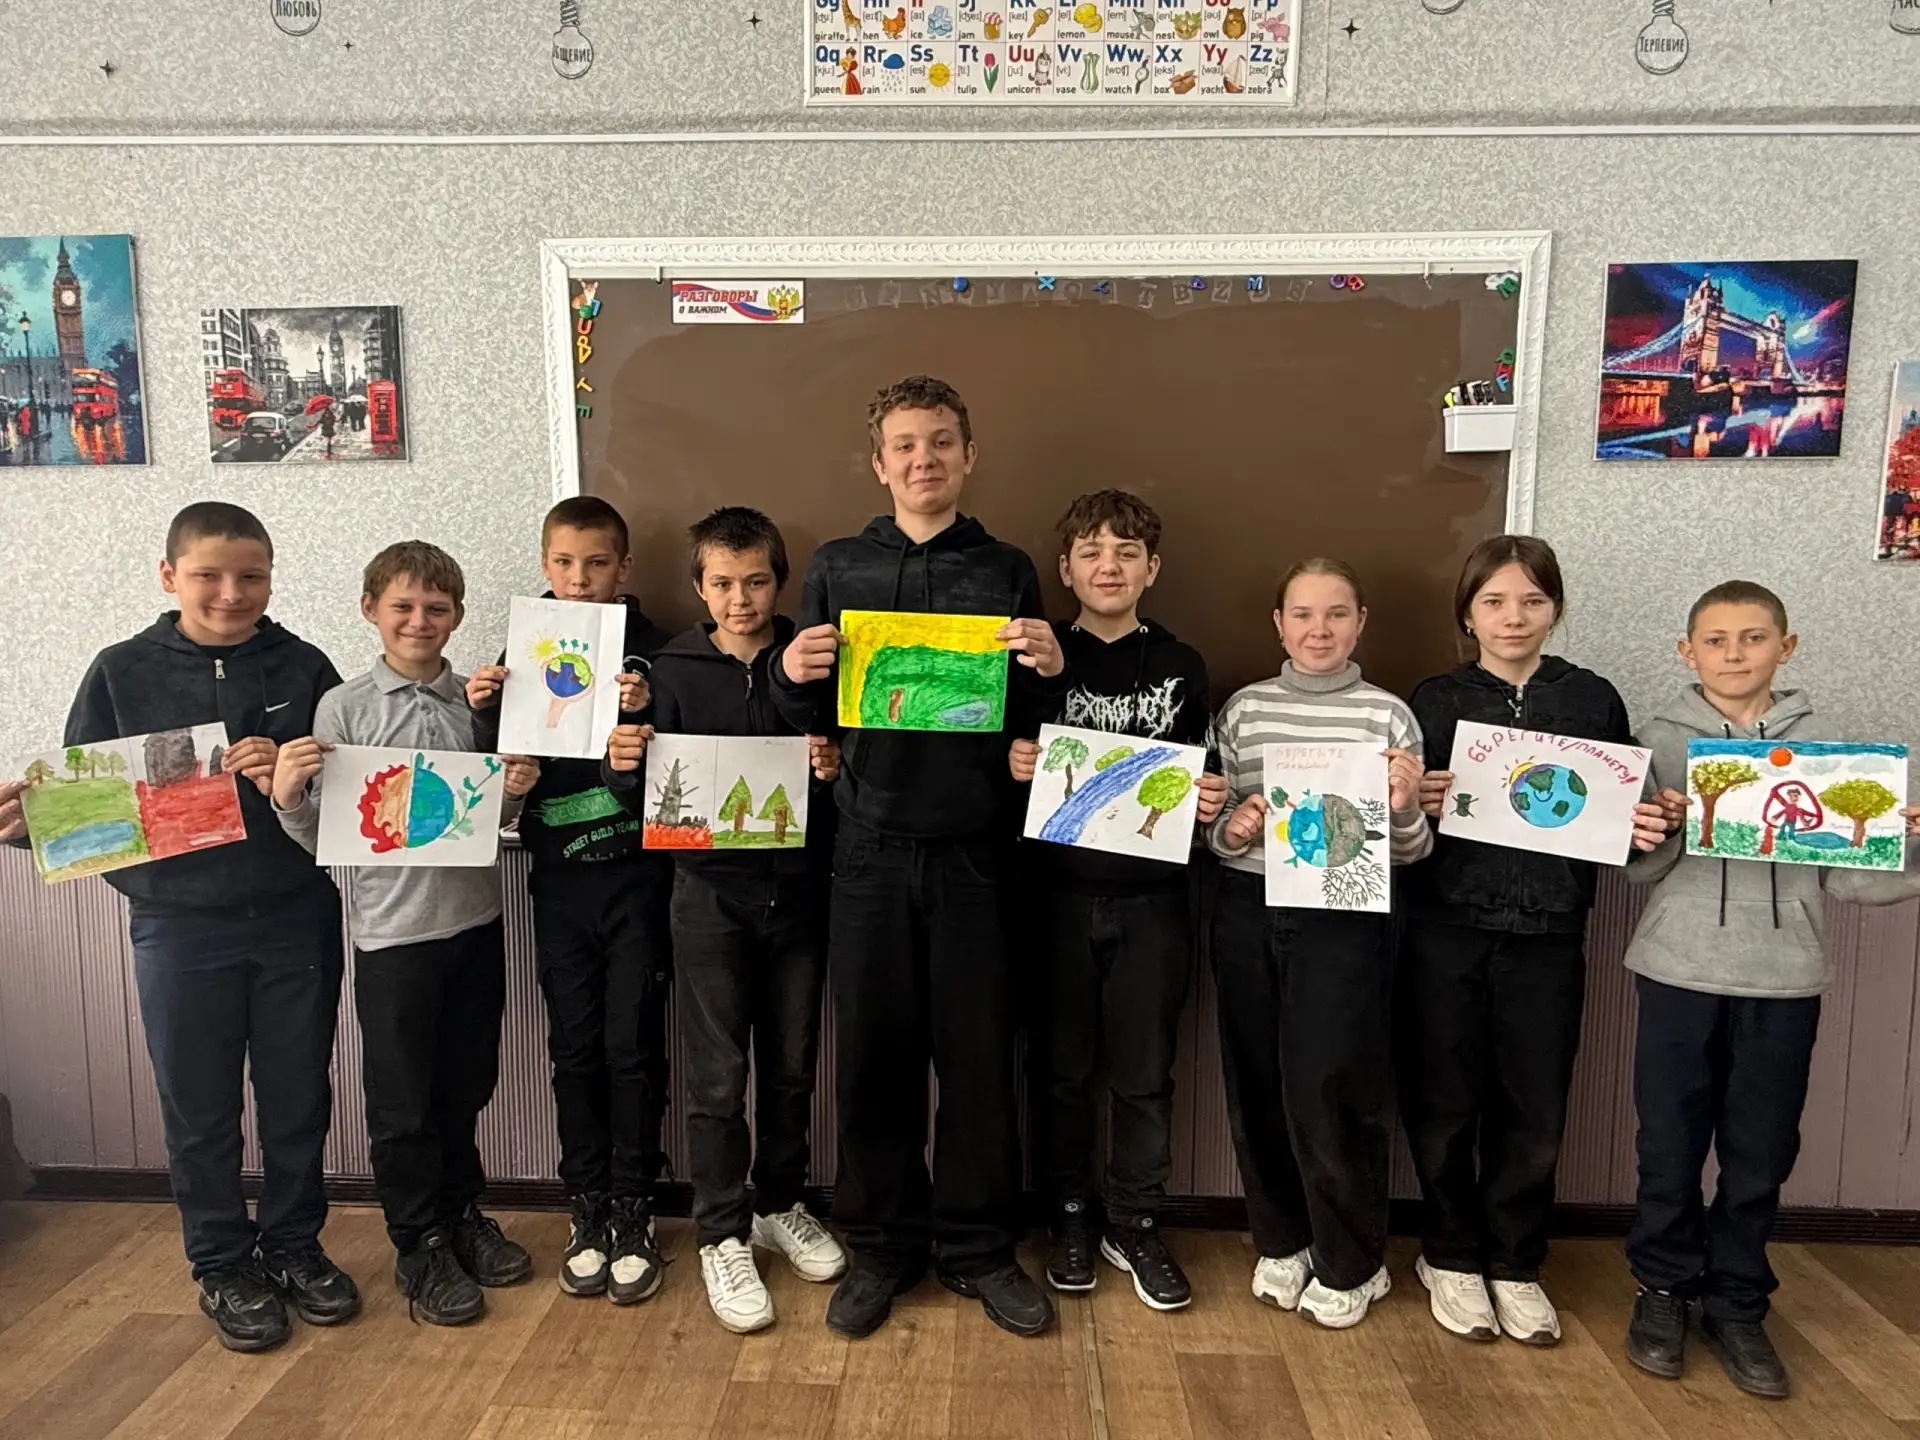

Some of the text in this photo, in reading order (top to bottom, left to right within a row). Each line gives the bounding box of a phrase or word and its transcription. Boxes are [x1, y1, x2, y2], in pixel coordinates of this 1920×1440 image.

[276, 0, 317, 17] ЛЮБОВЬ
[814, 31, 845, 43] giraffe
[862, 31, 879, 39] hen
[910, 30, 923, 39] ice
[958, 30, 975, 40] jam
[1008, 31, 1024, 41] key
[1057, 30, 1085, 39] lemon
[1106, 31, 1135, 39] mouse
[1155, 31, 1175, 39] nest
[1203, 30, 1219, 39] owl
[1250, 31, 1264, 41] pig
[816, 45, 840, 66] Qq
[863, 45, 887, 63] Rr
[910, 44, 934, 62] Ss
[958, 44, 979, 62] Tt
[1008, 45, 1034, 62] Uu
[1057, 44, 1082, 62] Vv
[1106, 44, 1144, 62] Ww
[1155, 45, 1183, 63] Xx
[1203, 44, 1228, 66] Yy
[1250, 45, 1273, 62] Zz
[814, 86, 841, 95] queen
[862, 85, 880, 94] rain
[910, 86, 926, 94] sun
[957, 85, 977, 95] tulip
[1007, 85, 1041, 94] unicorn
[1056, 86, 1076, 94] vase
[1105, 85, 1132, 94] watch
[1154, 85, 1171, 94] box
[1201, 85, 1224, 95] yacht
[1248, 85, 1272, 94] zebra
[678, 290, 759, 302] РАЗГОВОРЫ
[687, 305, 728, 314] ВАЖНОМ
[563, 834, 589, 858] STREET
[590, 826, 614, 841] GUILD
